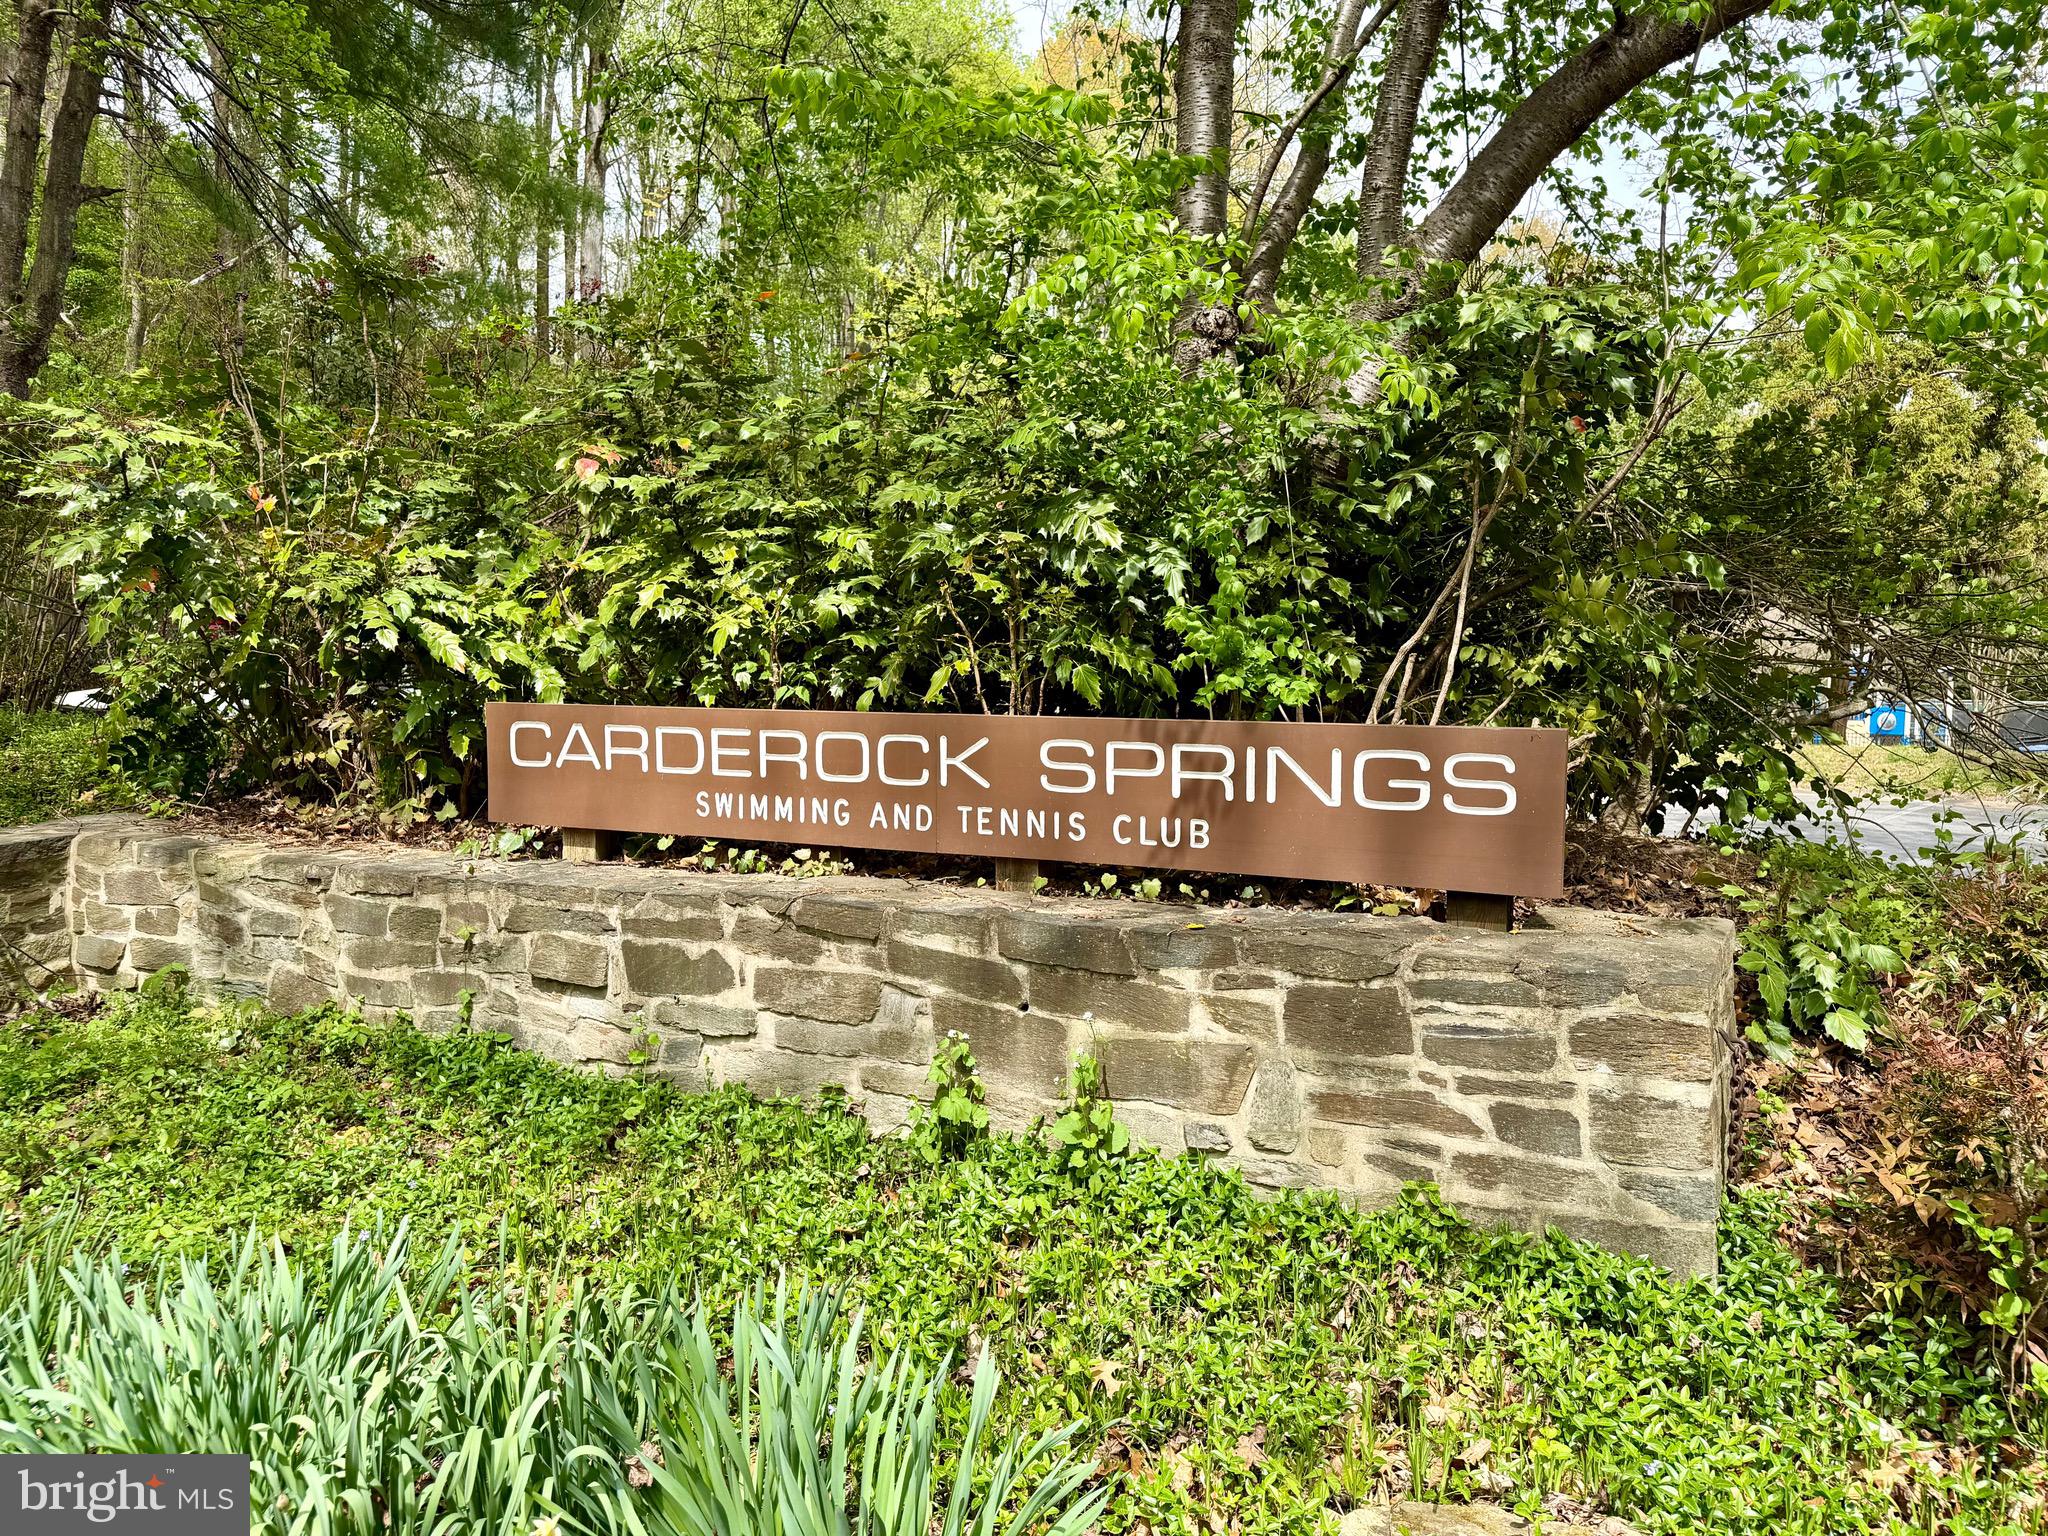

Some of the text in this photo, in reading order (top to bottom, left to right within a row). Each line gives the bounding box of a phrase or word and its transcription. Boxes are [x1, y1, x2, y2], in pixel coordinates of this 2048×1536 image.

[508, 719, 1518, 816] CARDEROCK SPRINGS
[695, 790, 1211, 850] SWIMMING AND TENNIS CLUB
